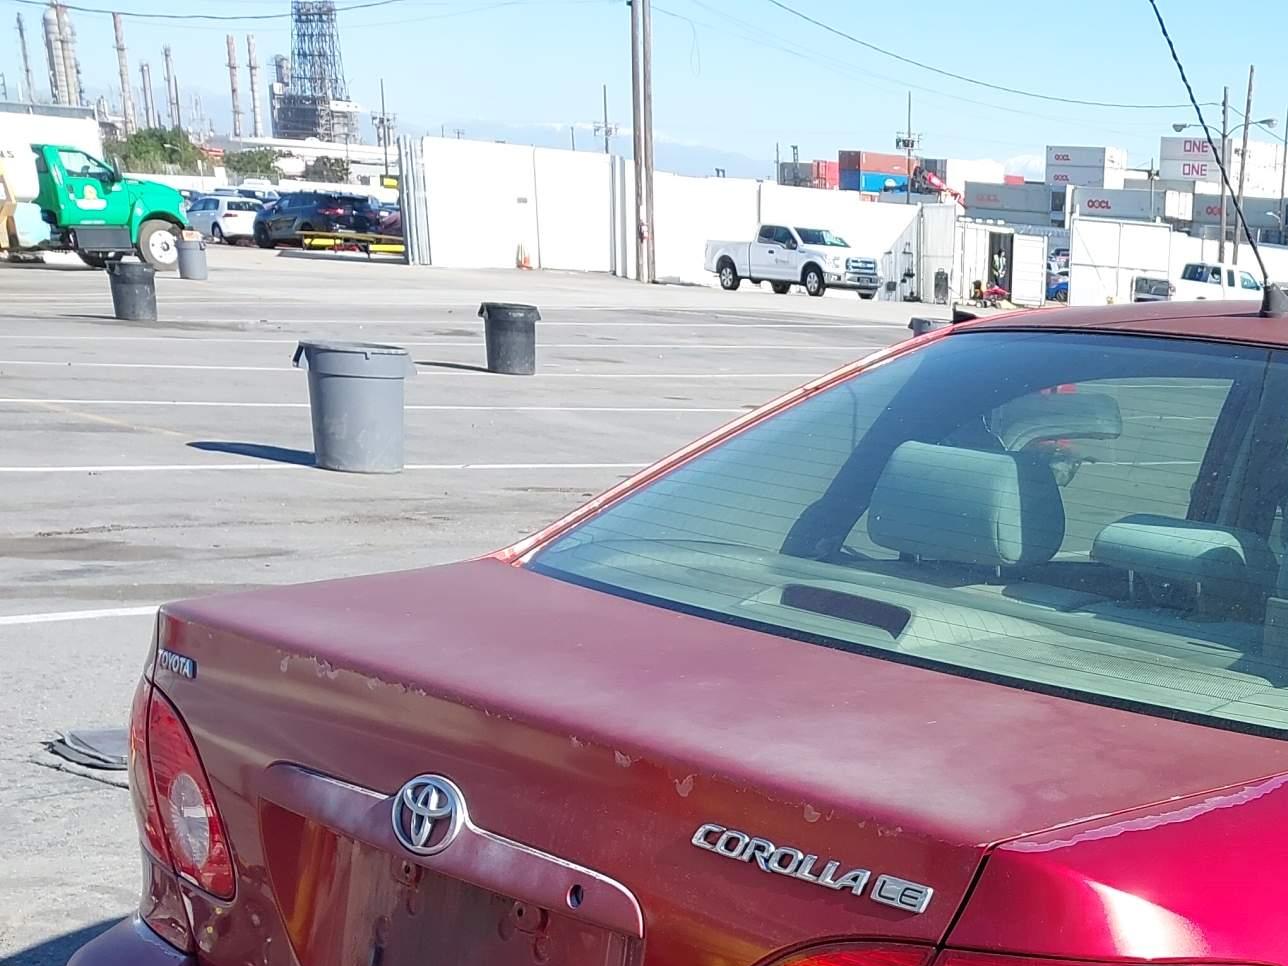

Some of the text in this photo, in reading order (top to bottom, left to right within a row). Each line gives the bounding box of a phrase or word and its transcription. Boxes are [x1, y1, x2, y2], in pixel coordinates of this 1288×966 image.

[1183, 140, 1209, 153] ONE
[1054, 153, 1071, 161] OOCL
[1182, 163, 1208, 177] ONE
[1053, 173, 1070, 182] OOCL
[1087, 199, 1112, 210] OOCL
[158, 648, 193, 679] TOYOTA
[691, 823, 928, 910] COROLLA LE
